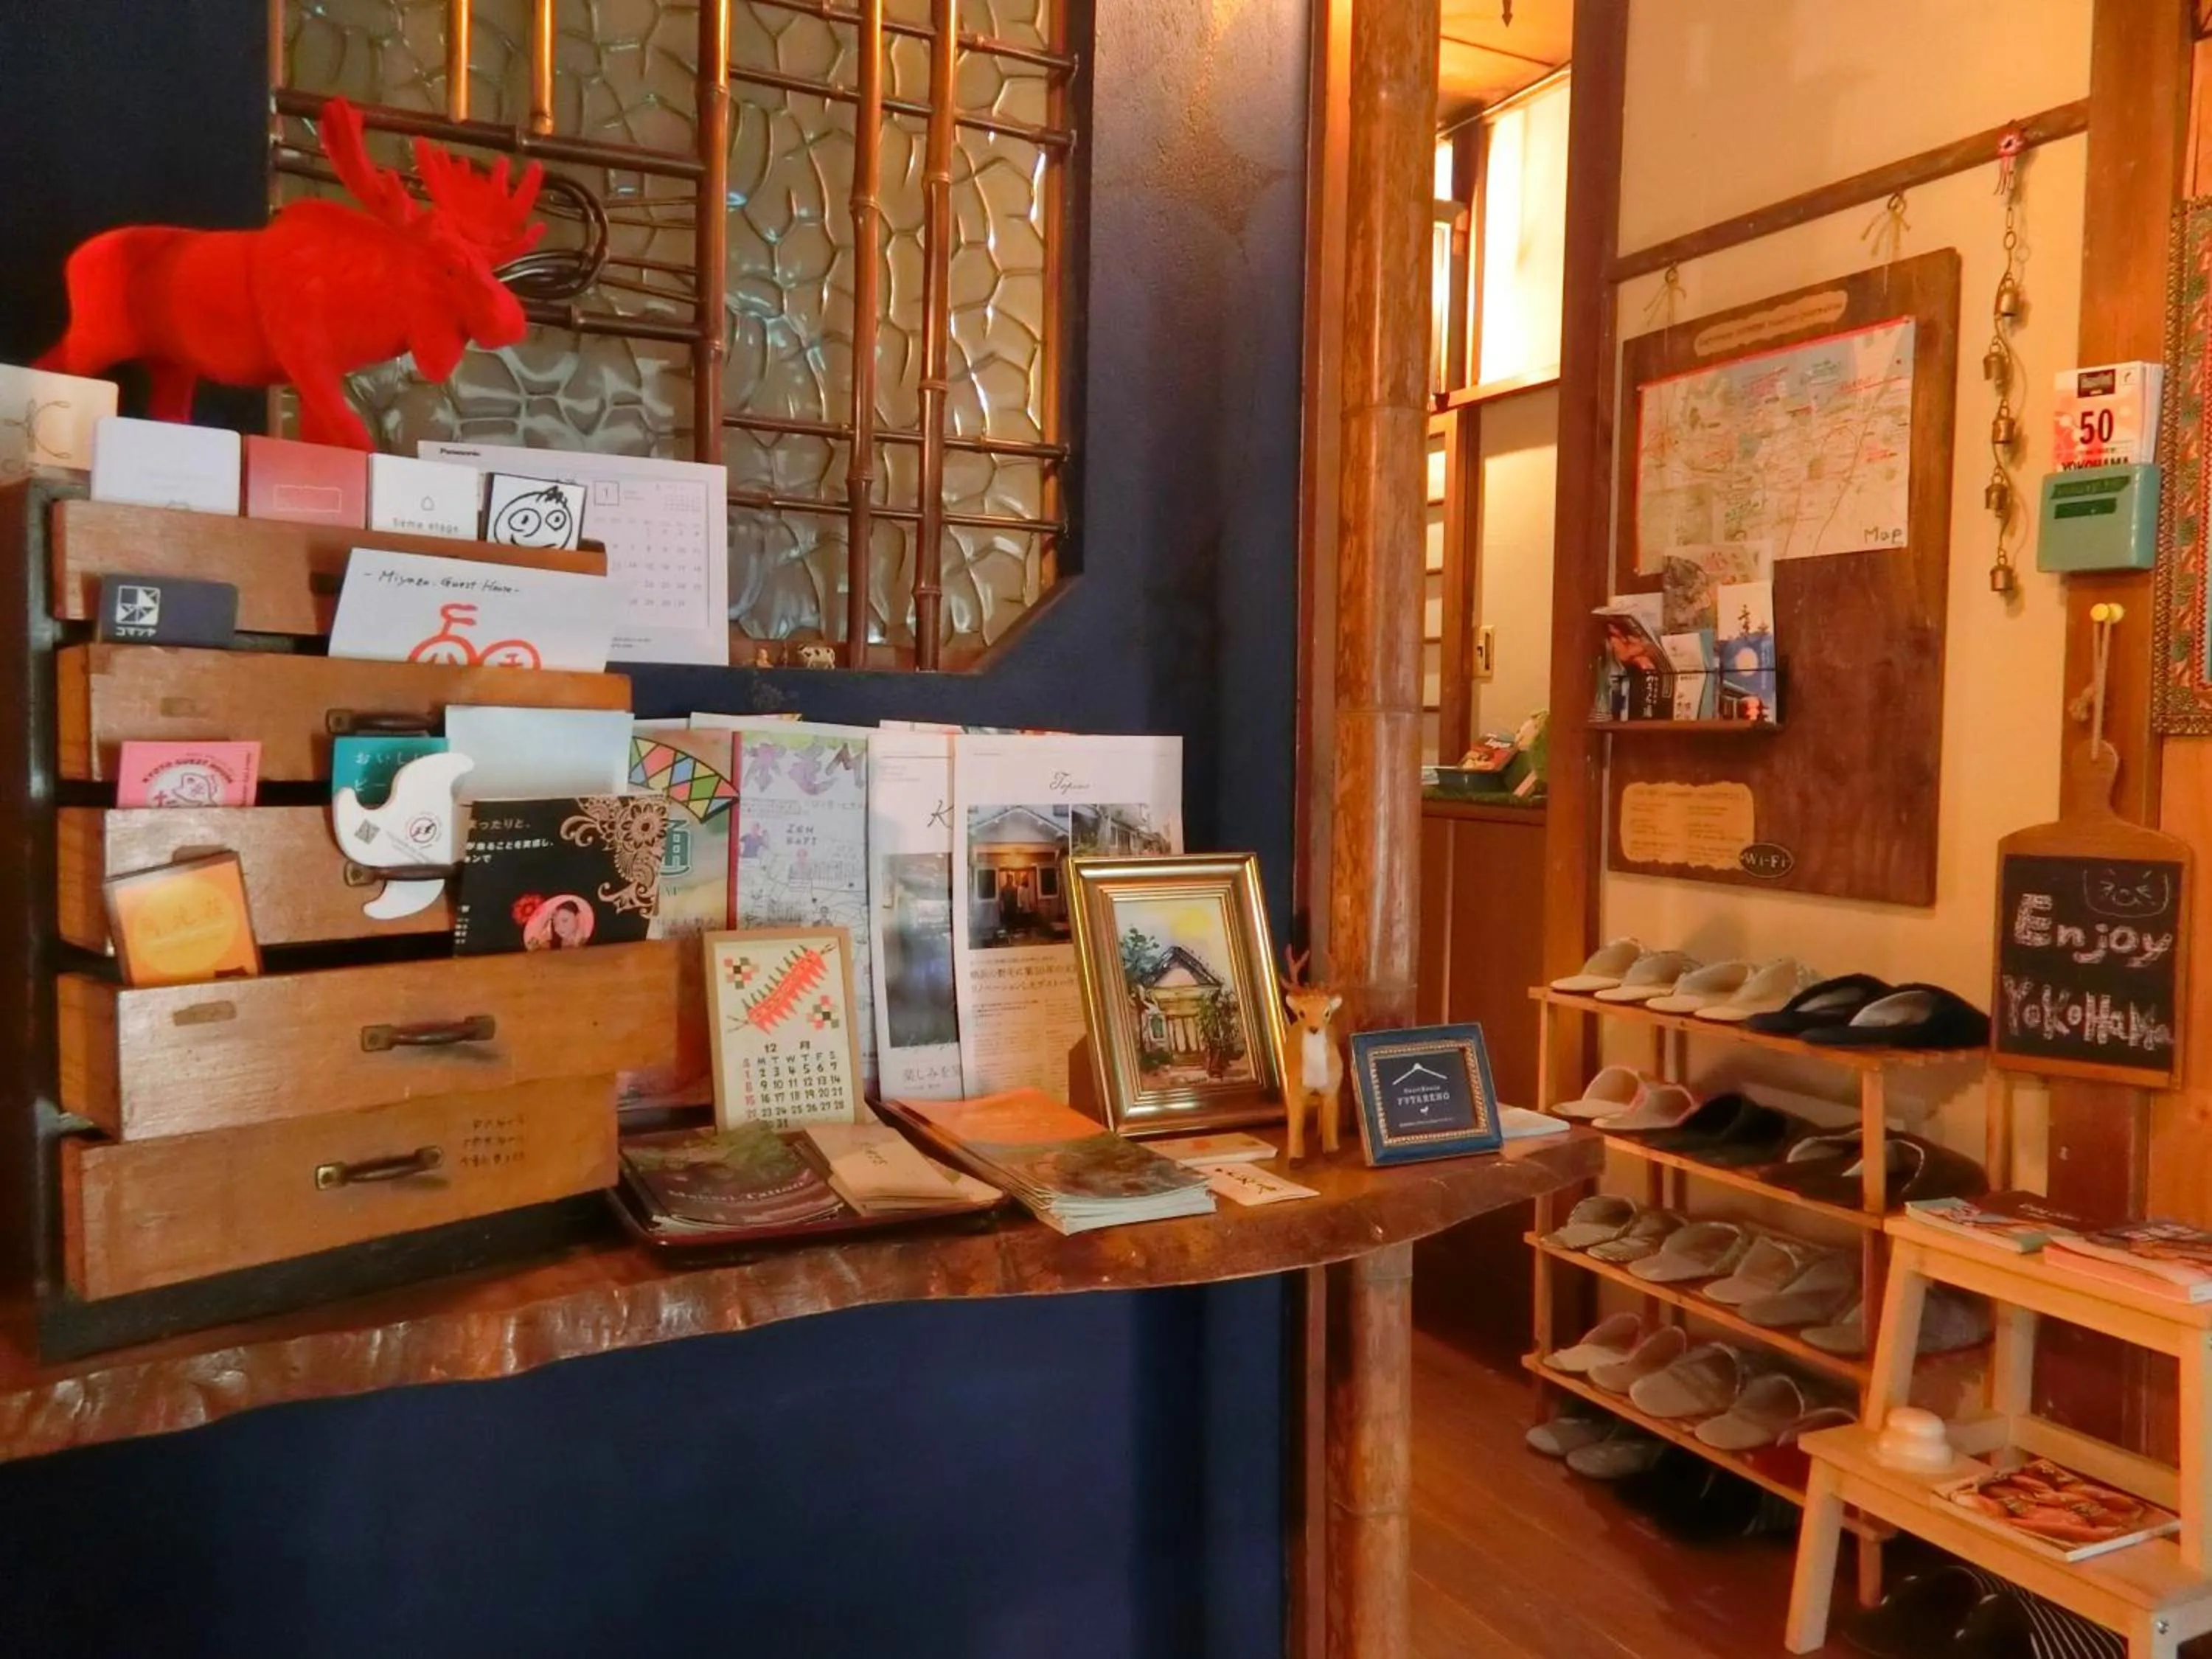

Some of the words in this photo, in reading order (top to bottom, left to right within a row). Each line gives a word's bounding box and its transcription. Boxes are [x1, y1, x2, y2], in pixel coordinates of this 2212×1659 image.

[2079, 408, 2114, 445] 50
[1863, 525, 1904, 545] Map
[440, 577, 478, 591] Guest
[481, 579, 512, 593] House
[1743, 852, 1786, 869] Wi-Fi
[2014, 892, 2174, 968] Enjoy
[765, 1043, 776, 1053] 12
[759, 1069, 765, 1077] 2
[774, 1067, 779, 1077] 3
[789, 1066, 796, 1074] 4
[804, 1064, 810, 1074] 5
[817, 1063, 824, 1072] 6
[830, 1062, 837, 1070] 7
[760, 1080, 768, 1090] 9
[773, 1080, 784, 1089] 10
[789, 1078, 798, 1088] 11
[804, 1077, 813, 1086] 12
[818, 1076, 827, 1085] 13
[830, 1076, 841, 1084] 14
[761, 1093, 770, 1103] 16
[775, 1093, 785, 1102] 17
[790, 1091, 800, 1101] 18
[805, 1089, 815, 1099] 19
[818, 1088, 830, 1097] 20
[832, 1087, 842, 1096] 21
[762, 1108, 772, 1117] 23
[776, 1107, 787, 1116] 24
[791, 1105, 802, 1114] 25
[806, 1104, 818, 1113] 26
[820, 1102, 831, 1111] 27
[834, 1101, 844, 1110] 28
[777, 1119, 788, 1128] 31
